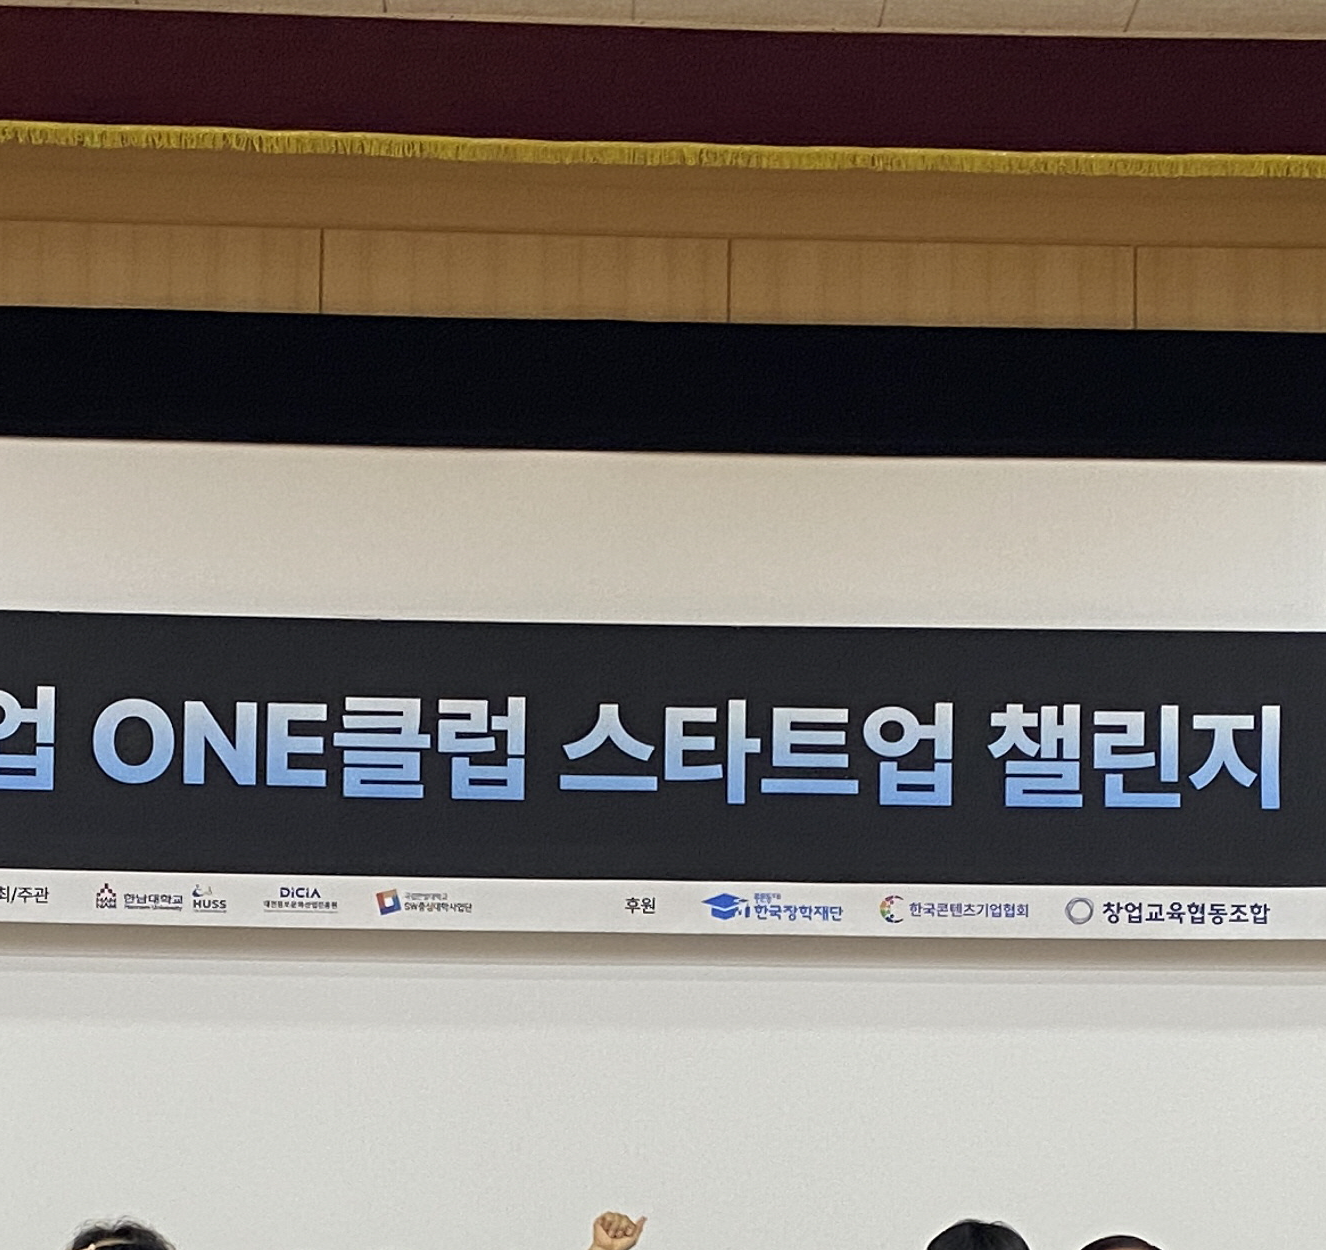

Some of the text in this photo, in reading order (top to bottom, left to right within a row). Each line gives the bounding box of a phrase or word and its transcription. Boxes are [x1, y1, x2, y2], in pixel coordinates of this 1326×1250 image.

[93, 697, 526, 800] ONE클럽
[560, 700, 953, 806] 스타트업
[988, 704, 1280, 809] 챌린지
[124, 893, 183, 904] 한남대학교
[193, 899, 227, 909] HUSS
[625, 897, 655, 914] 후원
[754, 903, 843, 921] 한국장학재단
[909, 902, 1028, 918] 한국콘텐츠기업협회
[1103, 902, 1270, 925] 창업교육협동조합
